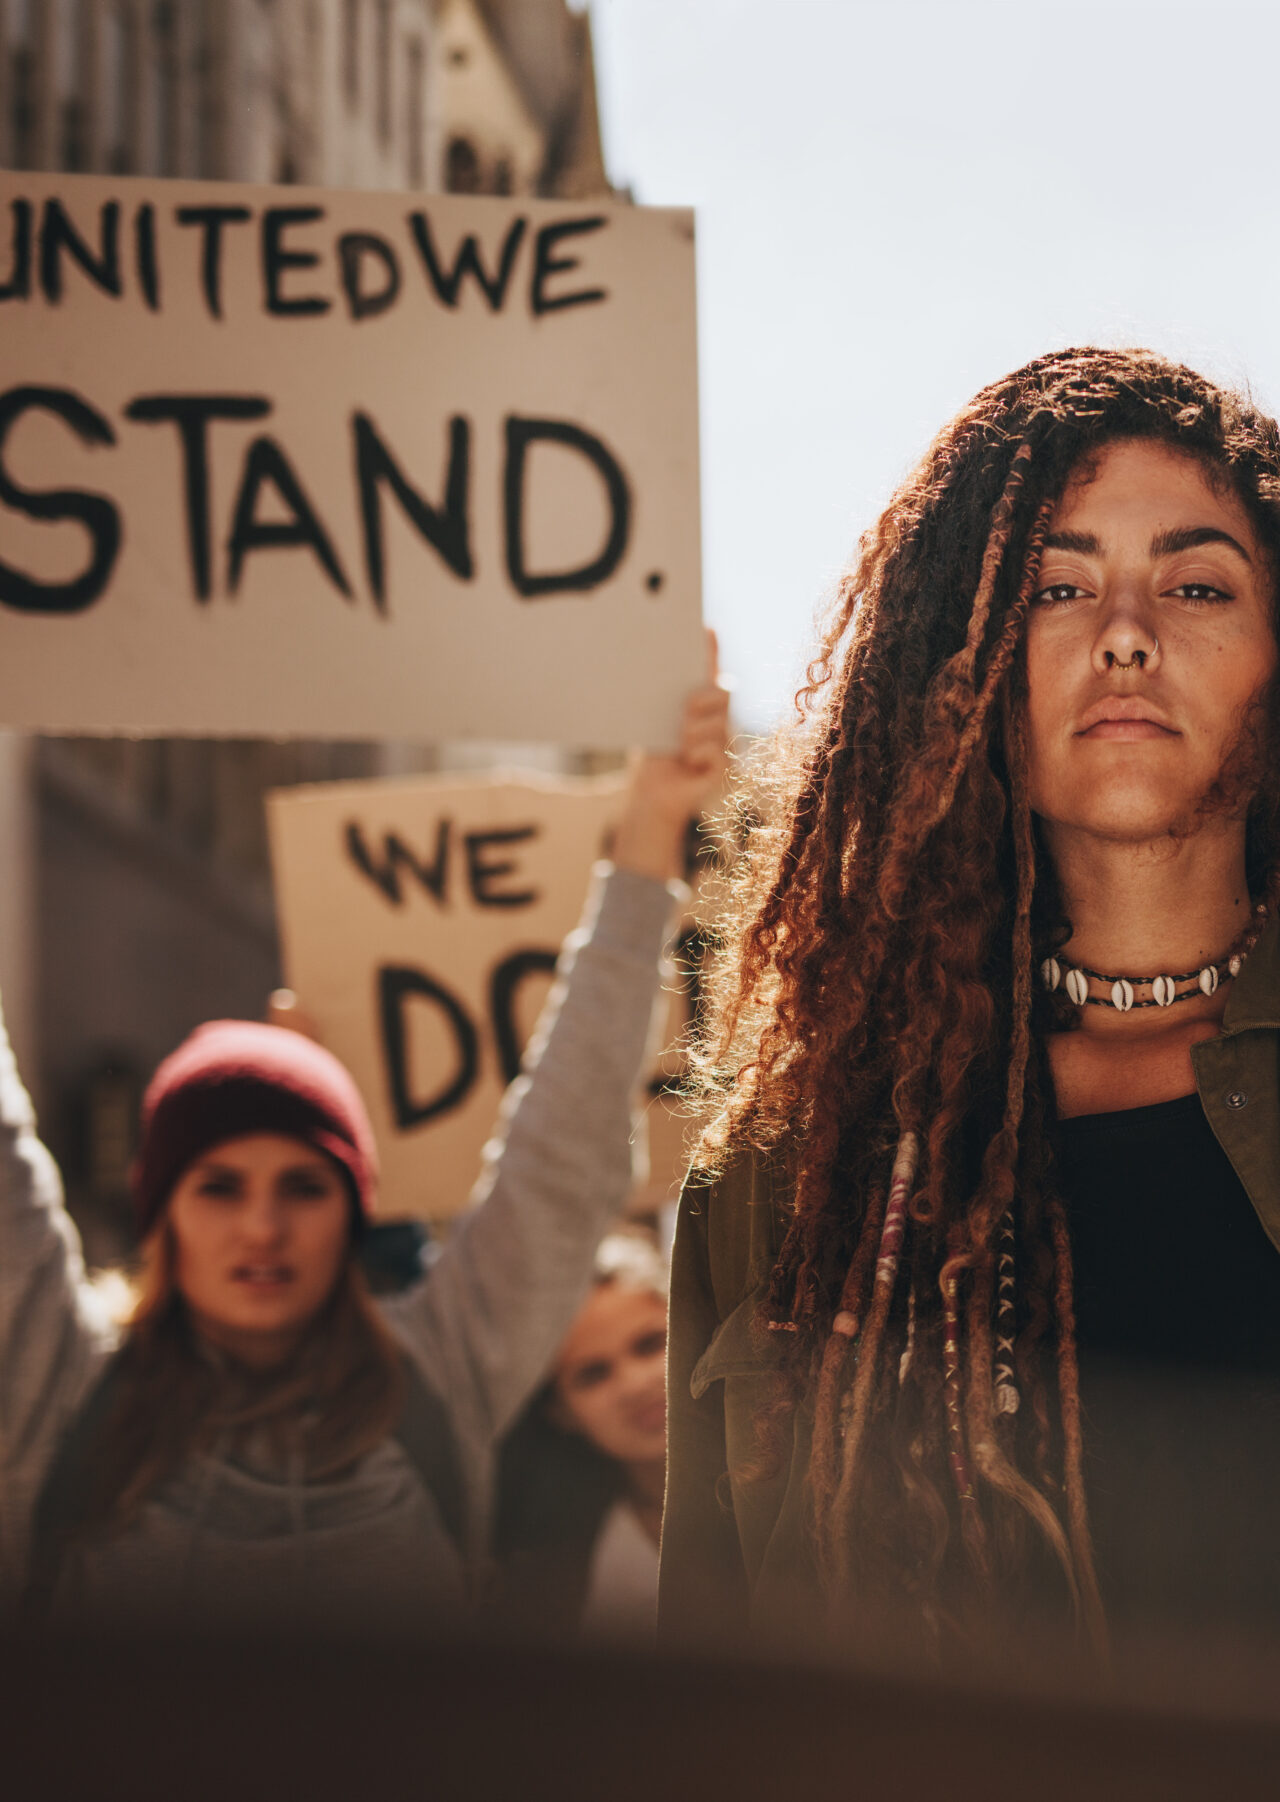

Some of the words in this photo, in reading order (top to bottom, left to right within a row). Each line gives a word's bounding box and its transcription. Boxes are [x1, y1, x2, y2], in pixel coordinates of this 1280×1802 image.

[406, 209, 609, 318] WE
[0, 380, 664, 618] STAND.
[344, 815, 541, 914] WE
